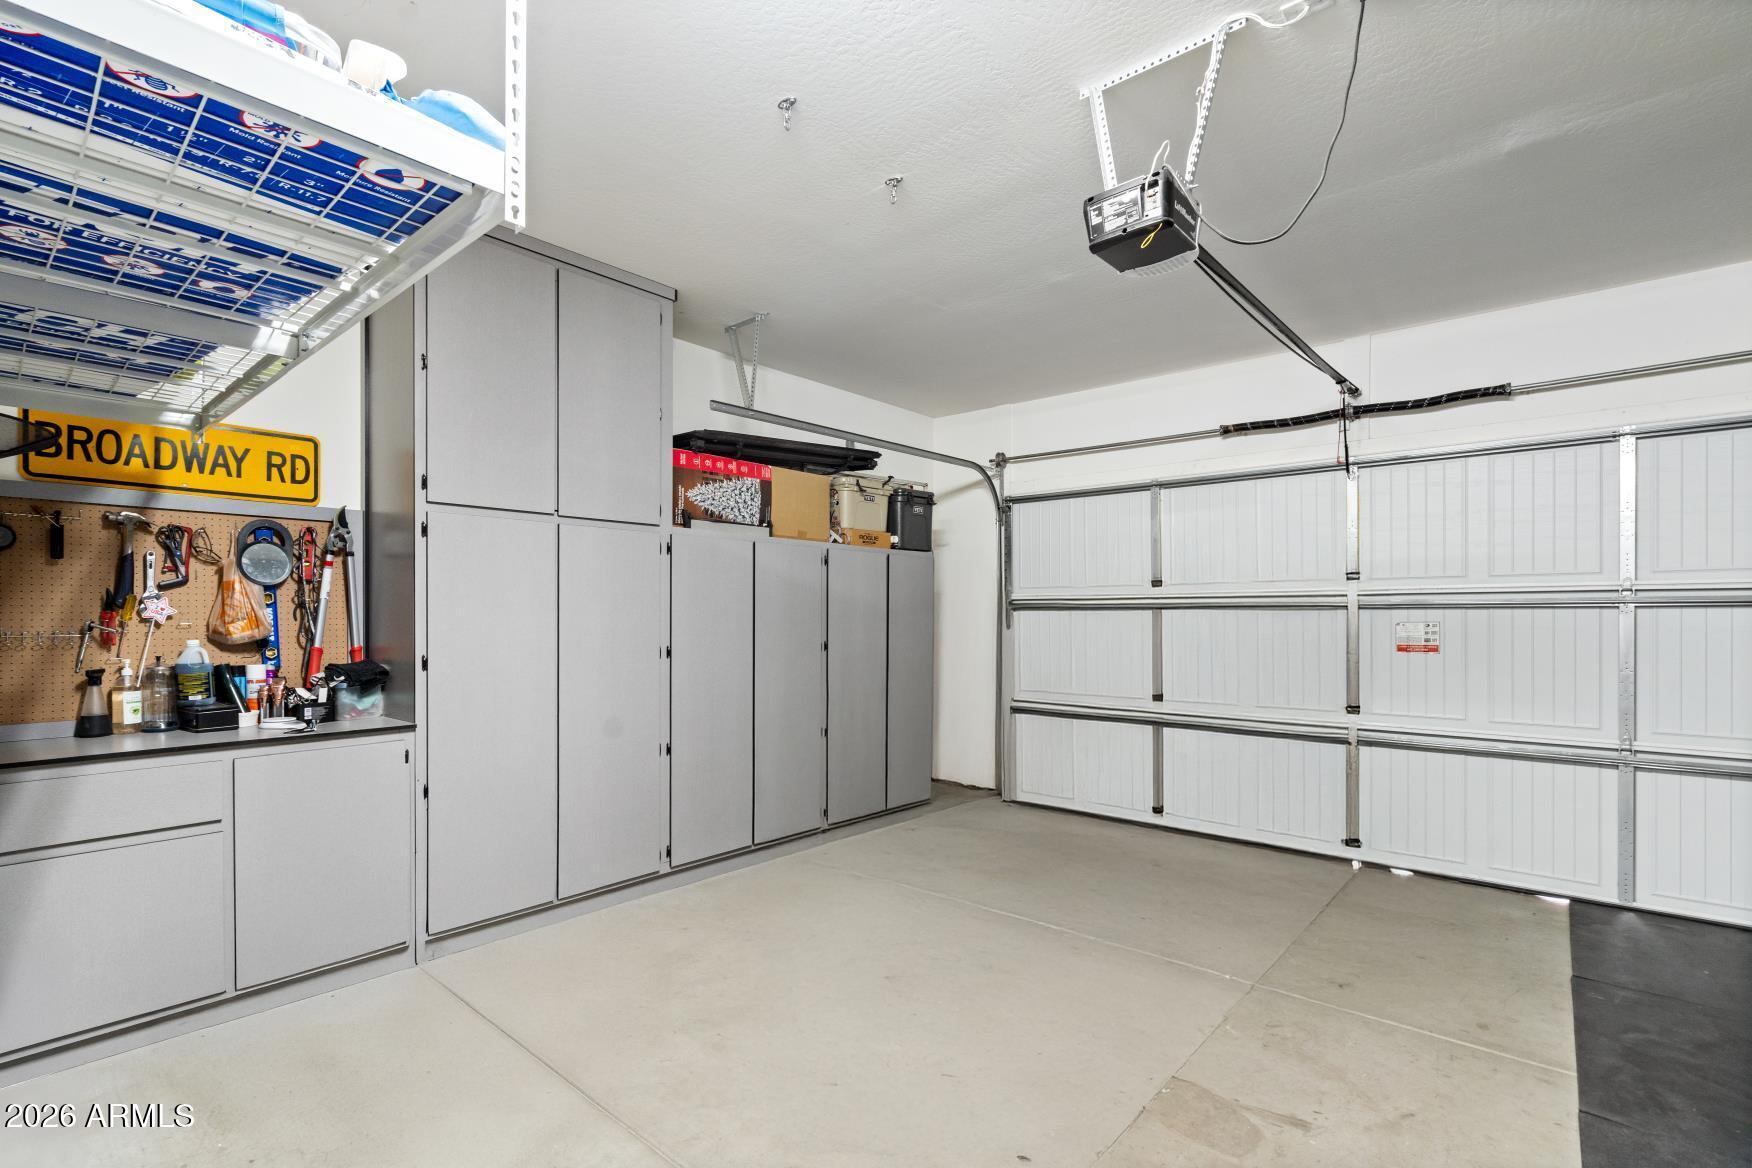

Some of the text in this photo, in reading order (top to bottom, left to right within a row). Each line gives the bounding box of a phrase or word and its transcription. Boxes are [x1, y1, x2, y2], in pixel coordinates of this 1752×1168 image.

[229, 127, 301, 158] Mold Resitant
[278, 182, 327, 202] R-11.7
[374, 185, 411, 203] Resistant
[8, 208, 242, 278] FOR EFFICIENCY
[34, 420, 310, 485] BROADWAY RD
